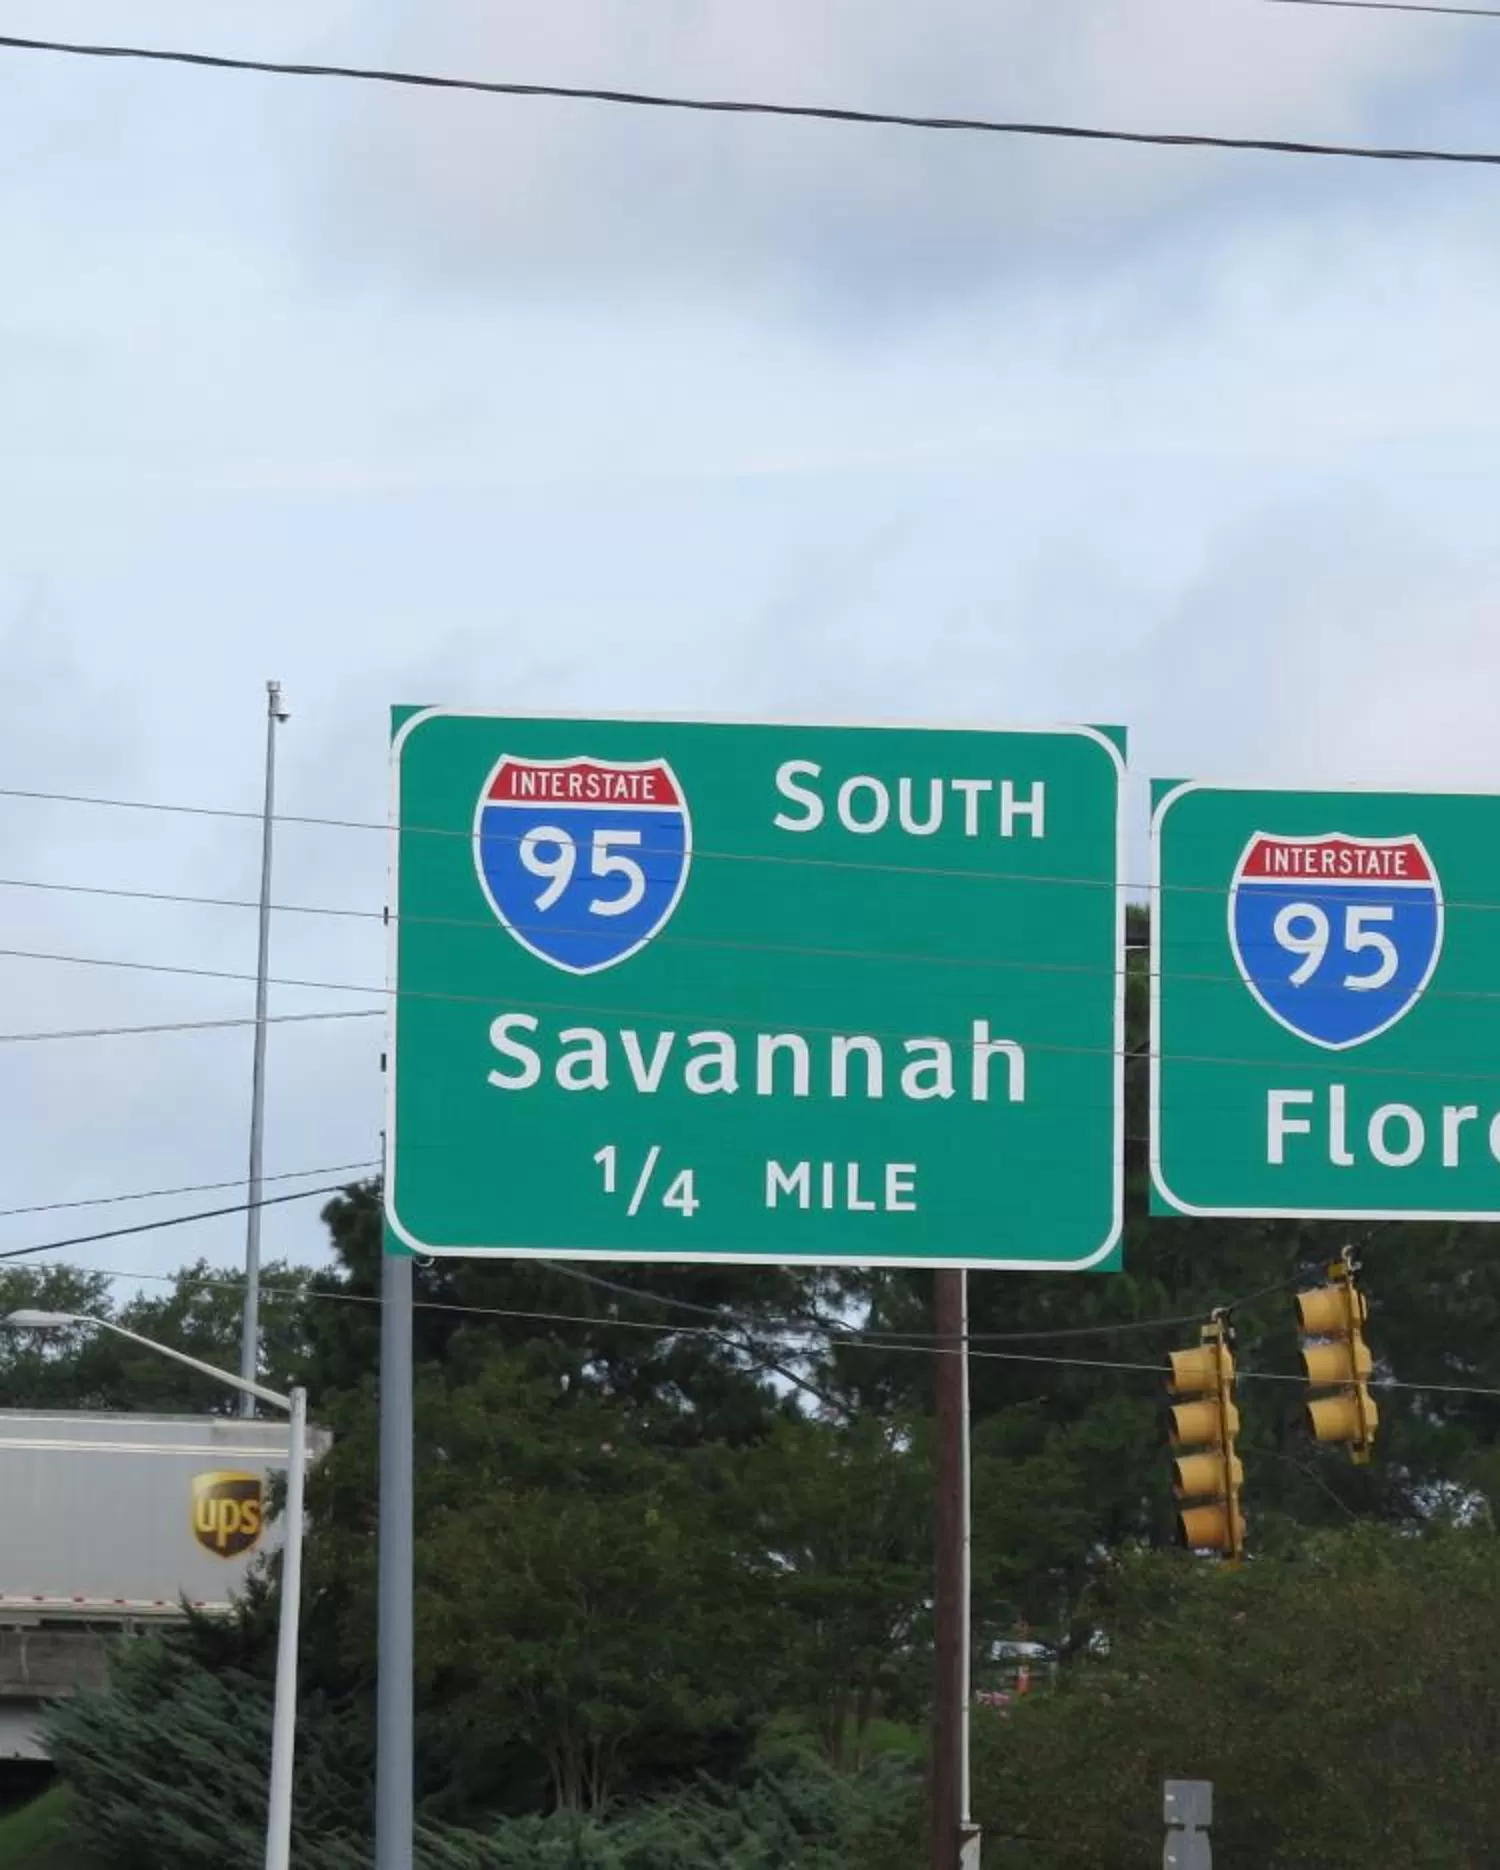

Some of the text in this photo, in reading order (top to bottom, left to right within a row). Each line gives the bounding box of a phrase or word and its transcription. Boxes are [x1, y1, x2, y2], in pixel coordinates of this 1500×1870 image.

[510, 770, 656, 800] INTERSTATE
[773, 759, 1046, 838] SOUTH
[518, 825, 647, 917] 95
[1263, 845, 1409, 878] INTERSTATE
[1272, 902, 1400, 992] 95
[486, 1012, 1026, 1103] Savannah
[592, 1144, 918, 1217] 1/4 MILE
[197, 1496, 261, 1548] ups
